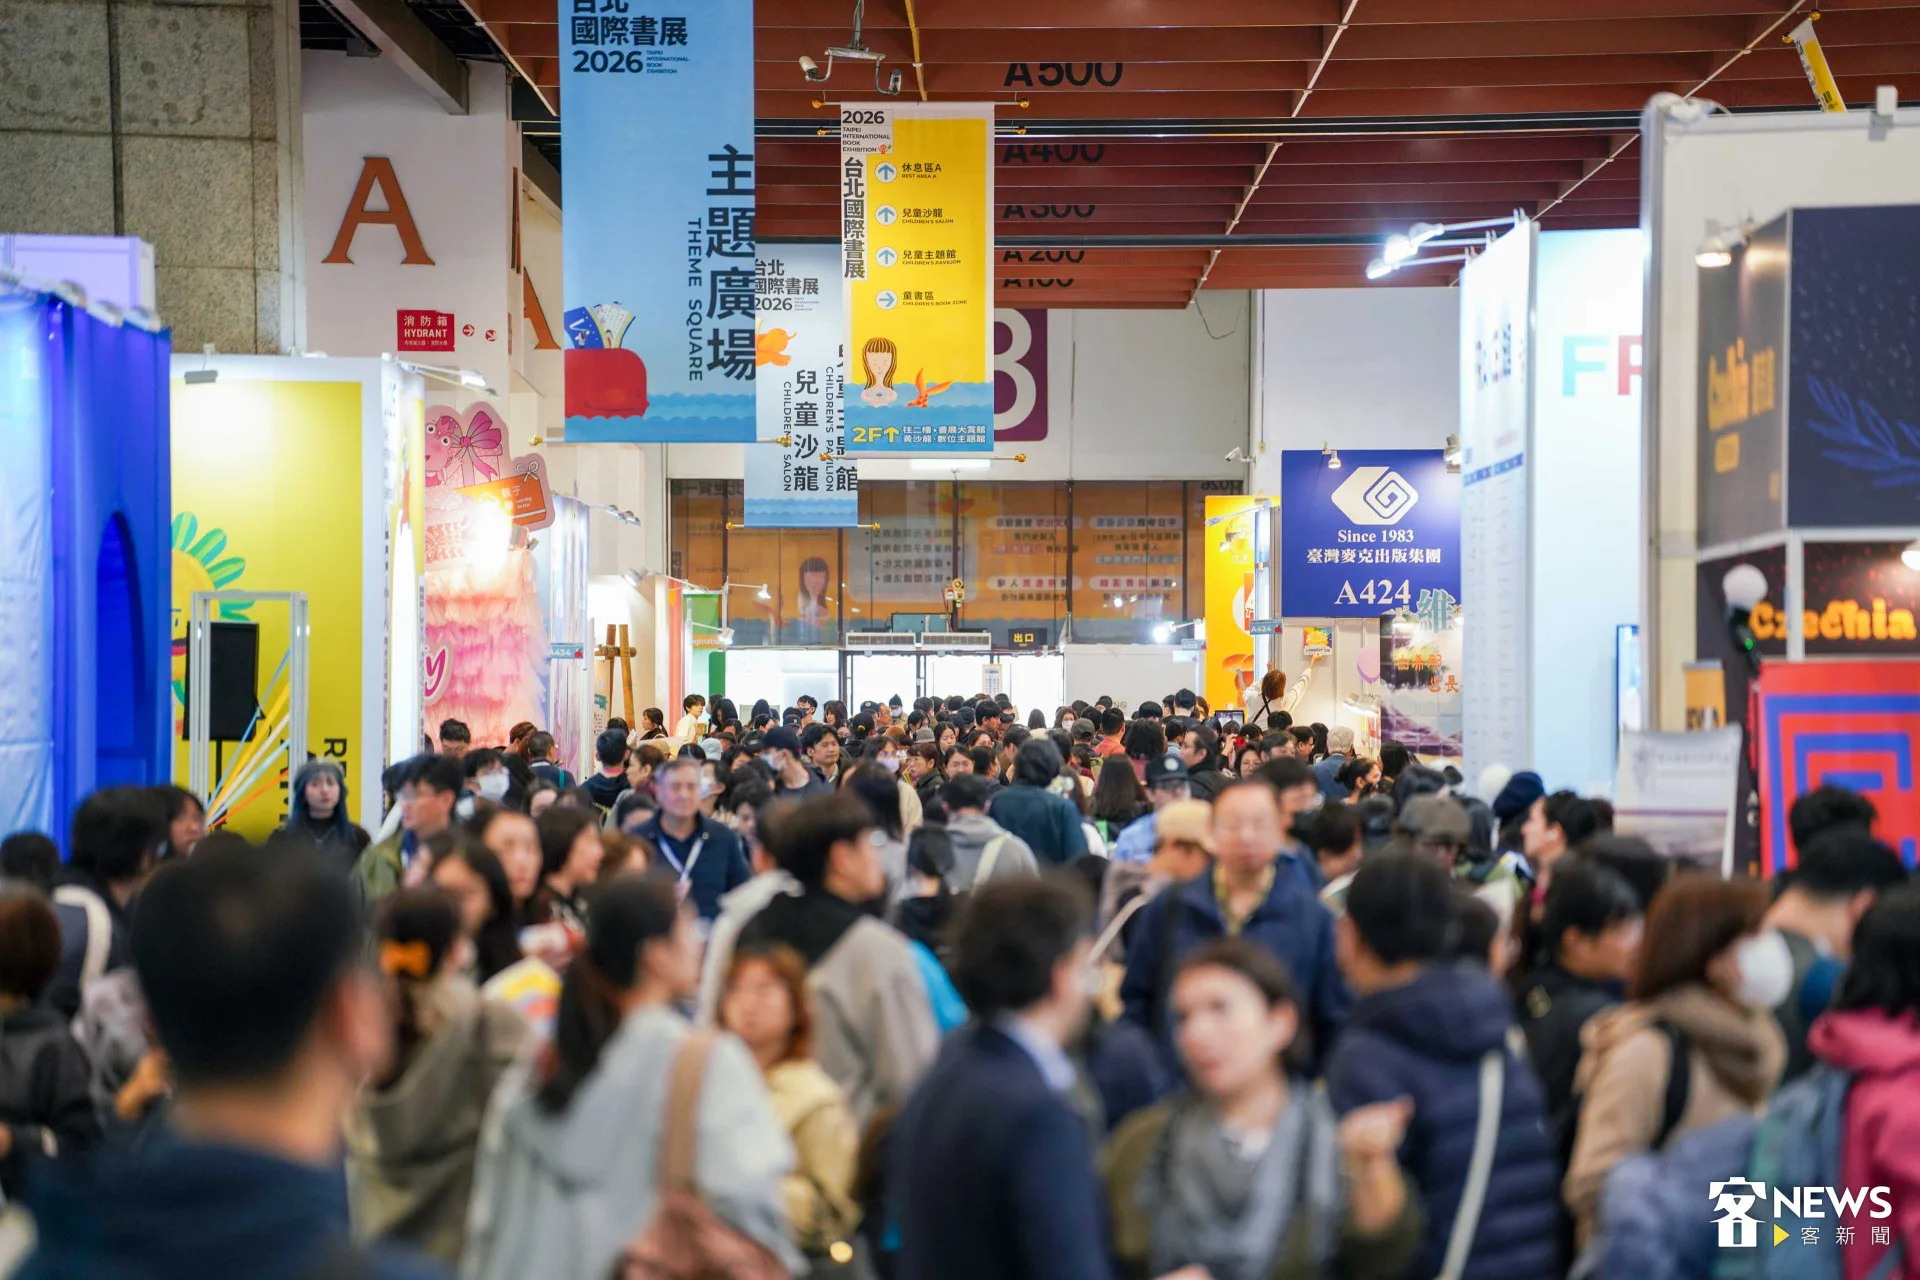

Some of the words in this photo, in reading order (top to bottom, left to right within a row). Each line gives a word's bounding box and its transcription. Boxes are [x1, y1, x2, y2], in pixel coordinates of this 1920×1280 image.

[571, 15, 688, 46] 國際書展
[572, 50, 643, 73] 2026
[1003, 62, 1123, 87] A500
[842, 110, 885, 124] 2026
[902, 162, 942, 172] 休息區A
[320, 156, 436, 266] A
[843, 156, 866, 279] 台北國際書展
[902, 208, 943, 218] 兒童沙龍
[687, 217, 702, 287] THEME
[705, 143, 756, 381] 主題廣場
[902, 249, 956, 260] 兒童主題館
[755, 277, 819, 295] 國際書展
[902, 290, 934, 301] 童書區
[404, 315, 448, 327] 消防箱
[404, 328, 448, 338] HYDRANT
[686, 299, 703, 381] SQUARE
[825, 366, 834, 433] CHILDREN'S
[793, 369, 819, 491] 兒童沙龍
[852, 426, 882, 443] 2F
[783, 454, 792, 492] SALON
[1337, 529, 1377, 543] Since
[1381, 529, 1414, 543] 1983
[1307, 548, 1442, 564] 臺灣麥克出版集團
[1333, 578, 1412, 605] A424
[1416, 587, 1457, 634] 維
[1013, 633, 1034, 643] 出口
[1250, 625, 1273, 633] A424
